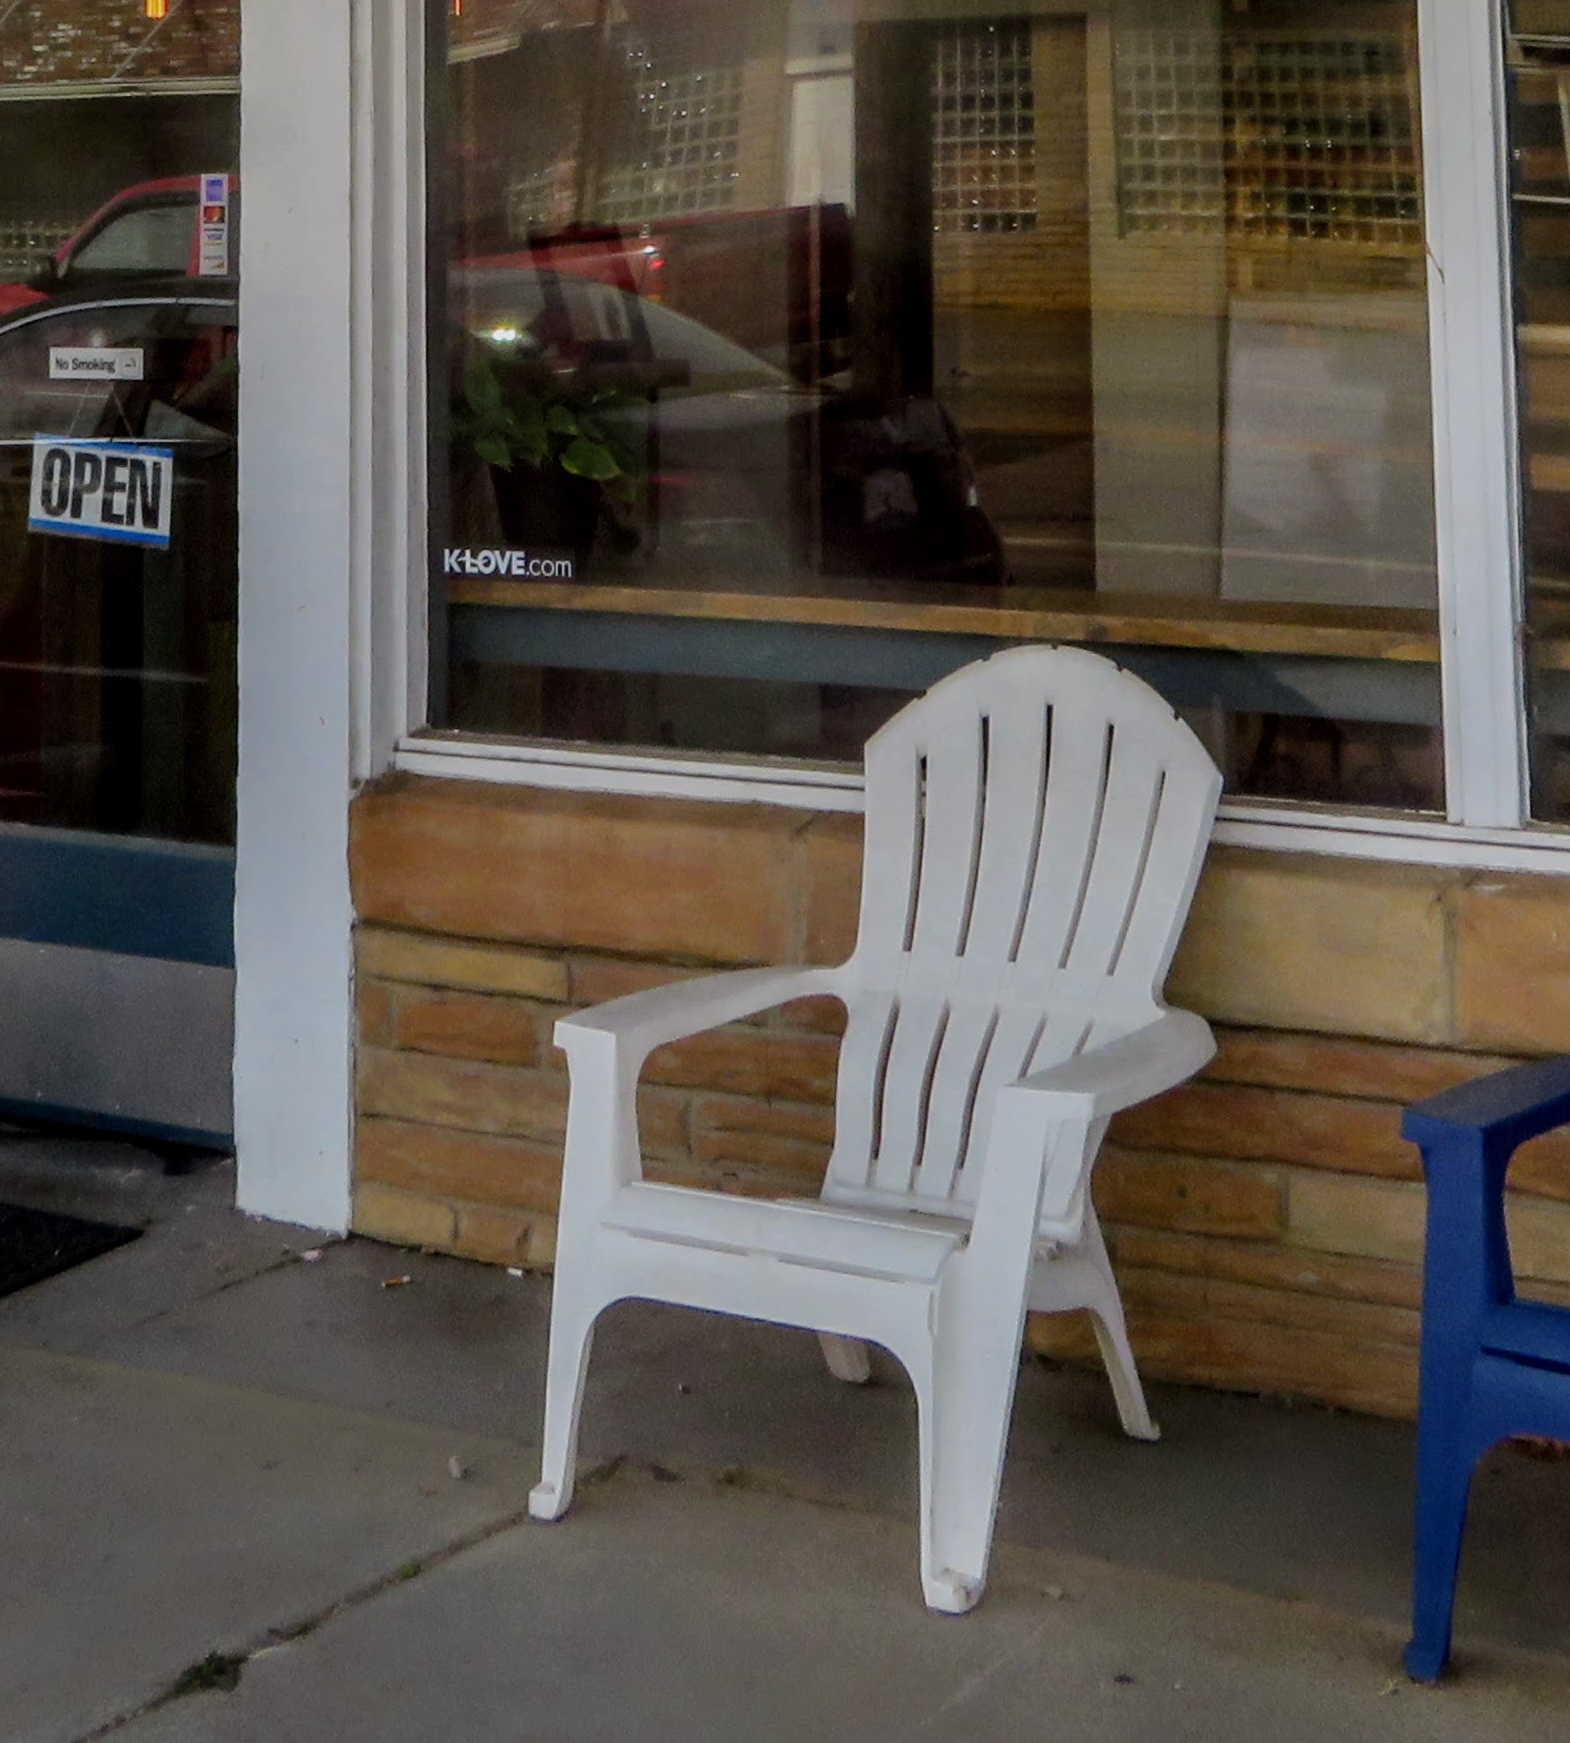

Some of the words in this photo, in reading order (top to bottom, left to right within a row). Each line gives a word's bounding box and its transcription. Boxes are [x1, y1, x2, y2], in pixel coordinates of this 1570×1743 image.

[55, 357, 69, 370] No
[72, 357, 116, 374] Smoking
[40, 447, 162, 529] OPEN
